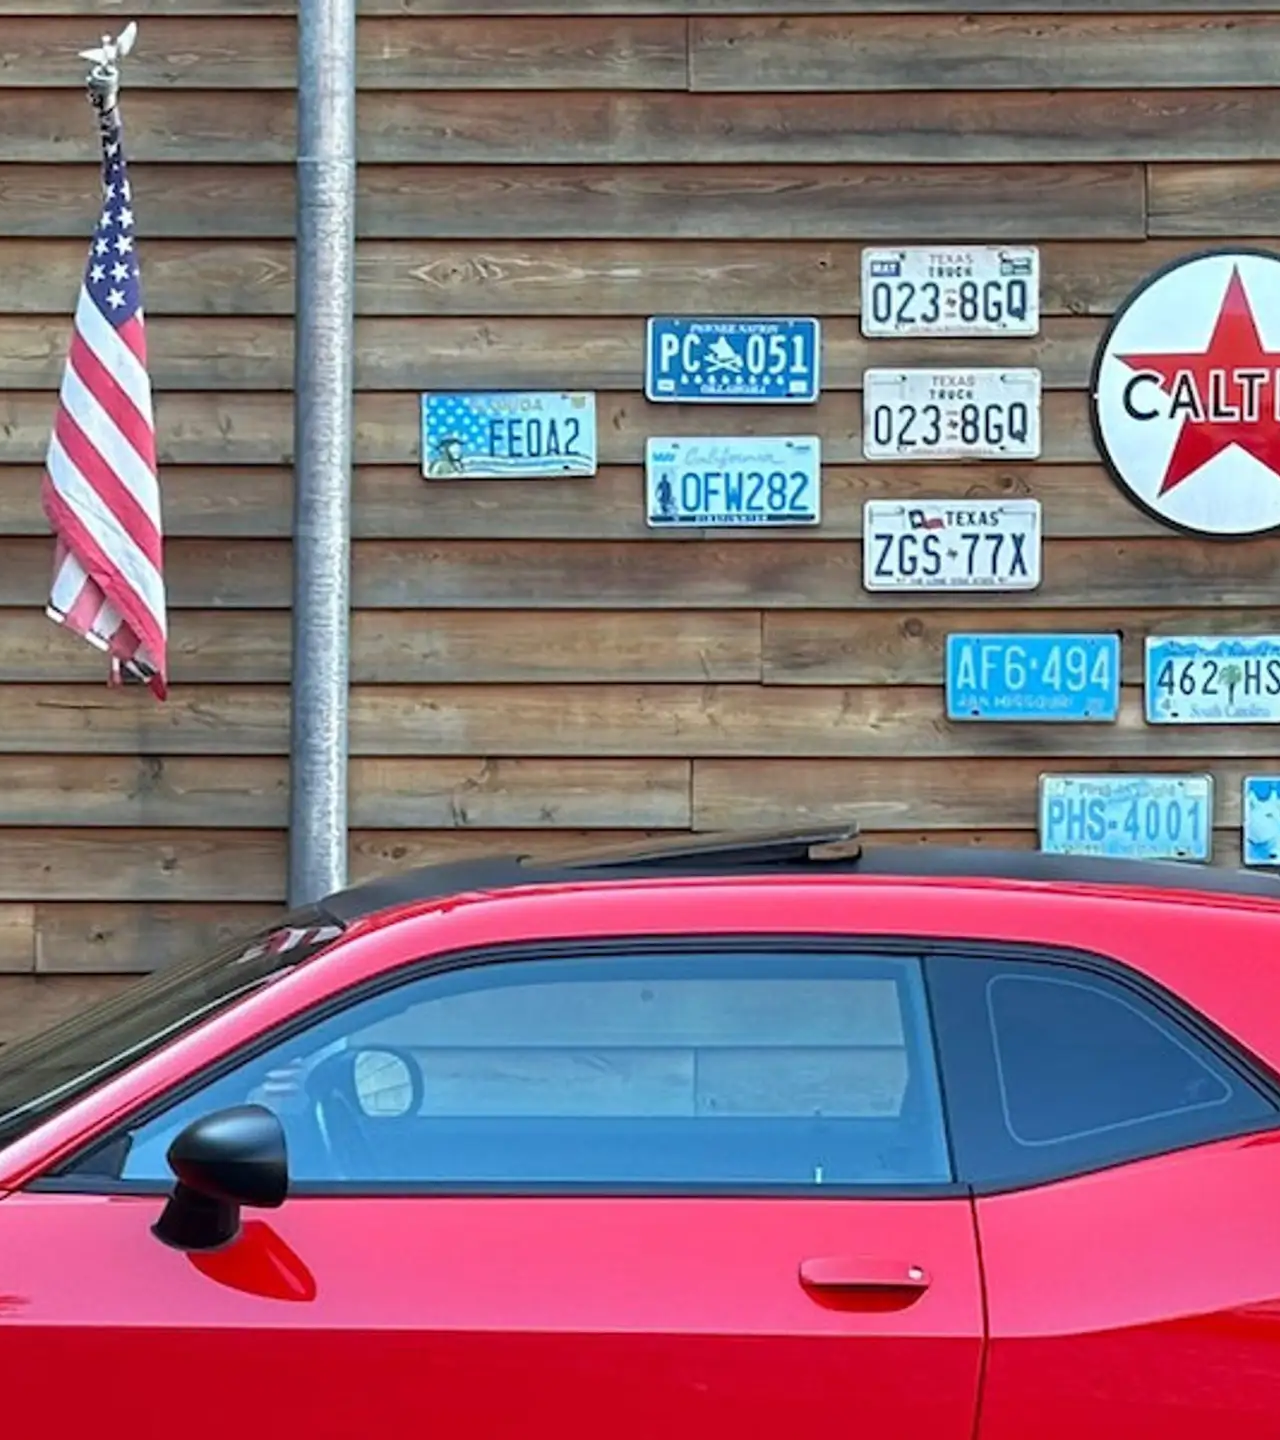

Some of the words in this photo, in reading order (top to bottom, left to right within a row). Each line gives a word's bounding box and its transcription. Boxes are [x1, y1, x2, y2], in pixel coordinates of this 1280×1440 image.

[928, 266, 973, 278] TRUCK
[929, 253, 974, 264] TEXAS
[873, 282, 940, 323] 023
[959, 280, 1027, 322] 8GQ
[660, 334, 701, 373] PC
[746, 335, 809, 374] 051
[931, 375, 976, 386] TEXAS
[929, 389, 974, 400] TRUCK
[874, 405, 941, 446] 023
[961, 402, 1028, 444] 8GQ
[945, 510, 1000, 527] TEXAS
[874, 533, 941, 577] ZGS
[961, 533, 1028, 576] 77X
[1157, 659, 1218, 696] 462
